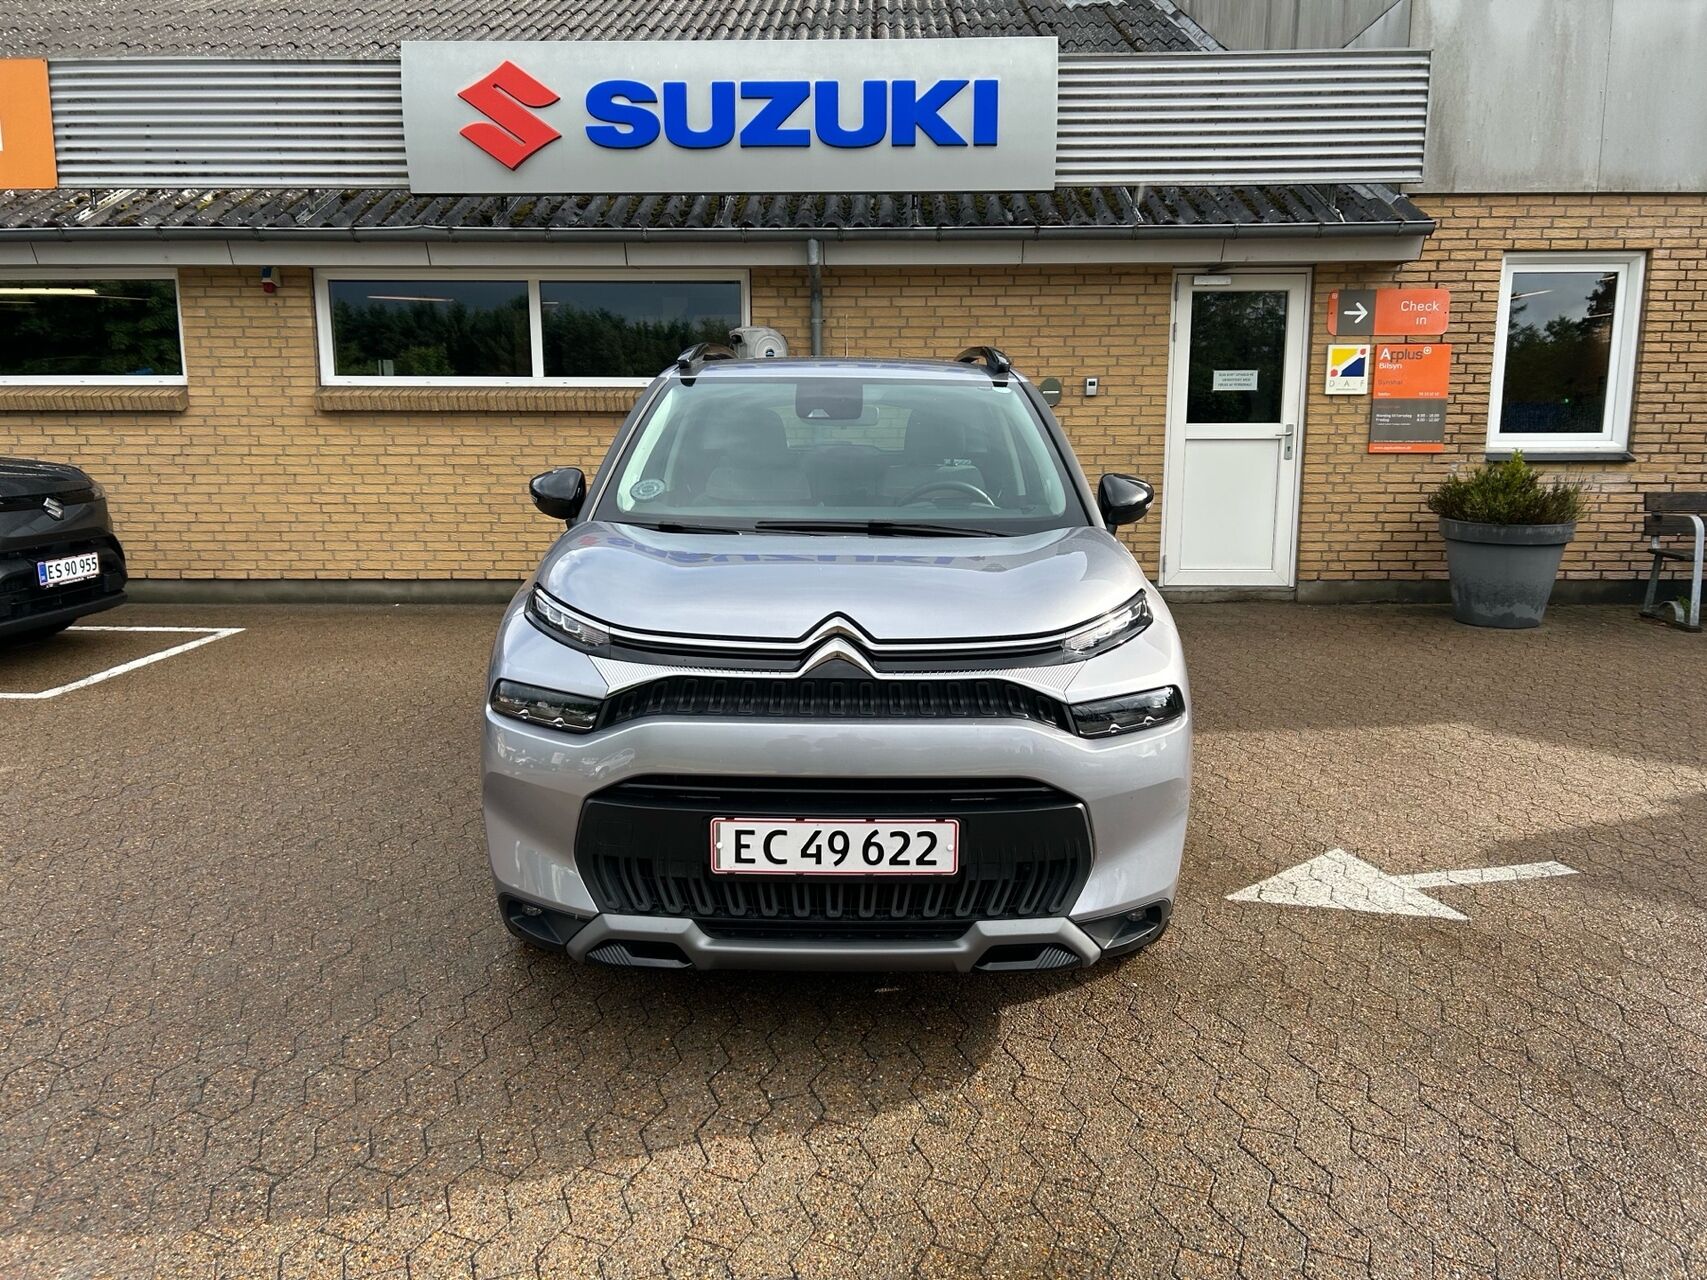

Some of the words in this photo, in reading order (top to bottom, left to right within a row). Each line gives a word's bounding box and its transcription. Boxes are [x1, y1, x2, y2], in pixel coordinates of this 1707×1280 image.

[586, 79, 999, 149] SUZUKI
[1401, 300, 1440, 312] Check
[1416, 317, 1427, 326] in
[1379, 362, 1403, 371] Bilsyn
[48, 563, 62, 580] ES
[64, 560, 77, 576] 90
[79, 557, 97, 573] 955
[734, 829, 788, 865] EC
[800, 829, 850, 867] 49
[862, 829, 938, 866] 622
